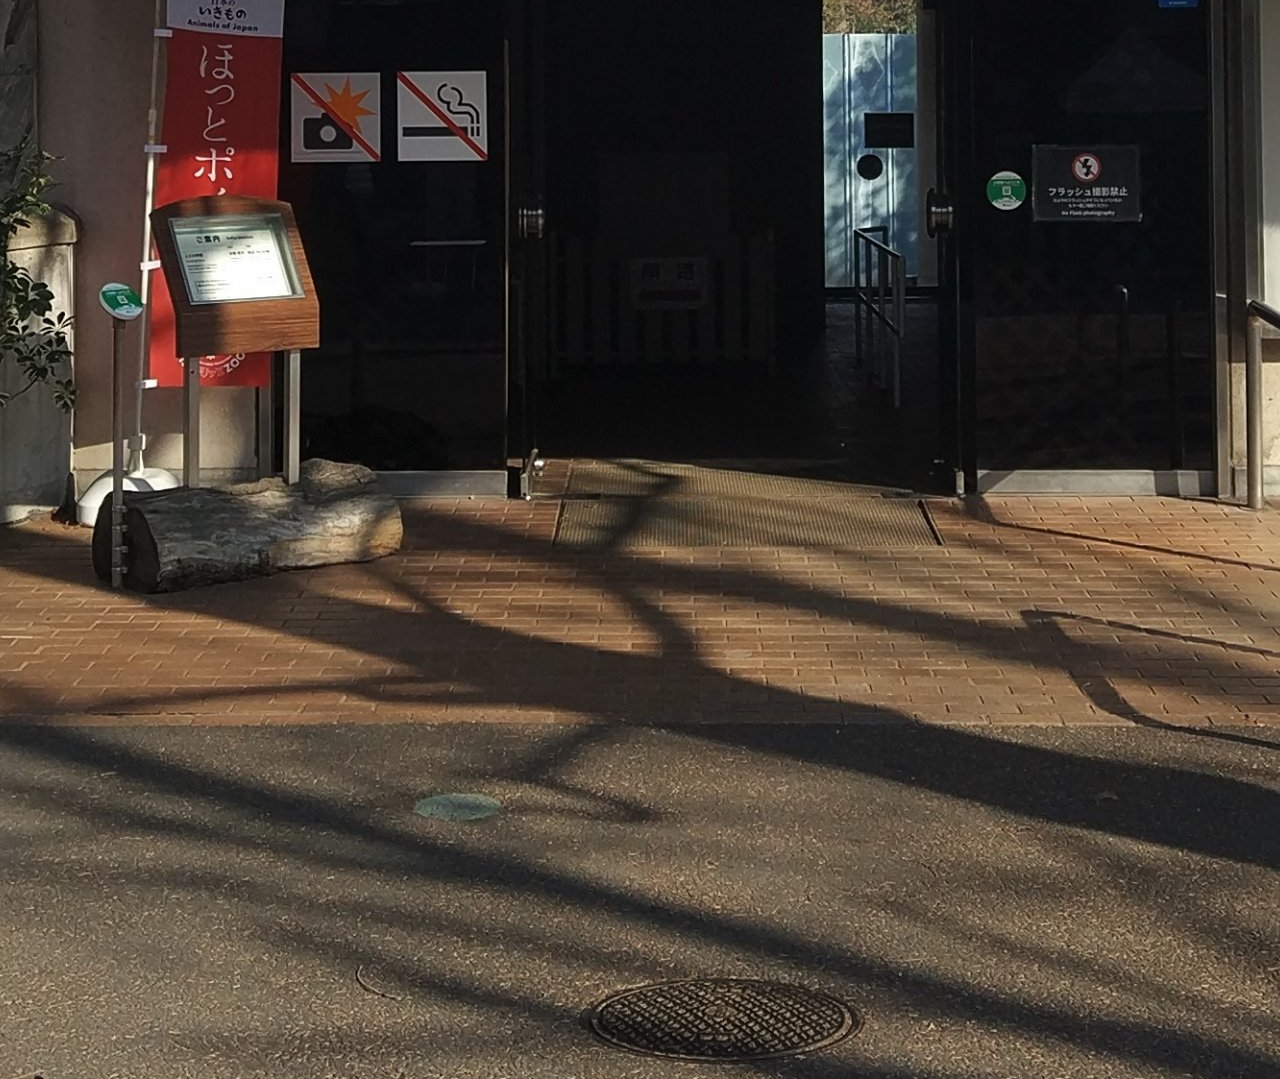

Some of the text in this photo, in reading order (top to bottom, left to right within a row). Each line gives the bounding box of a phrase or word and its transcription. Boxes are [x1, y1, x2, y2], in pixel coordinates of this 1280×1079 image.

[198, 6, 247, 20] いきもの
[187, 18, 259, 33] Animals of Japan
[193, 44, 235, 196] ほっとポ
[1048, 186, 1128, 197] フラッシュ撮影禁止
